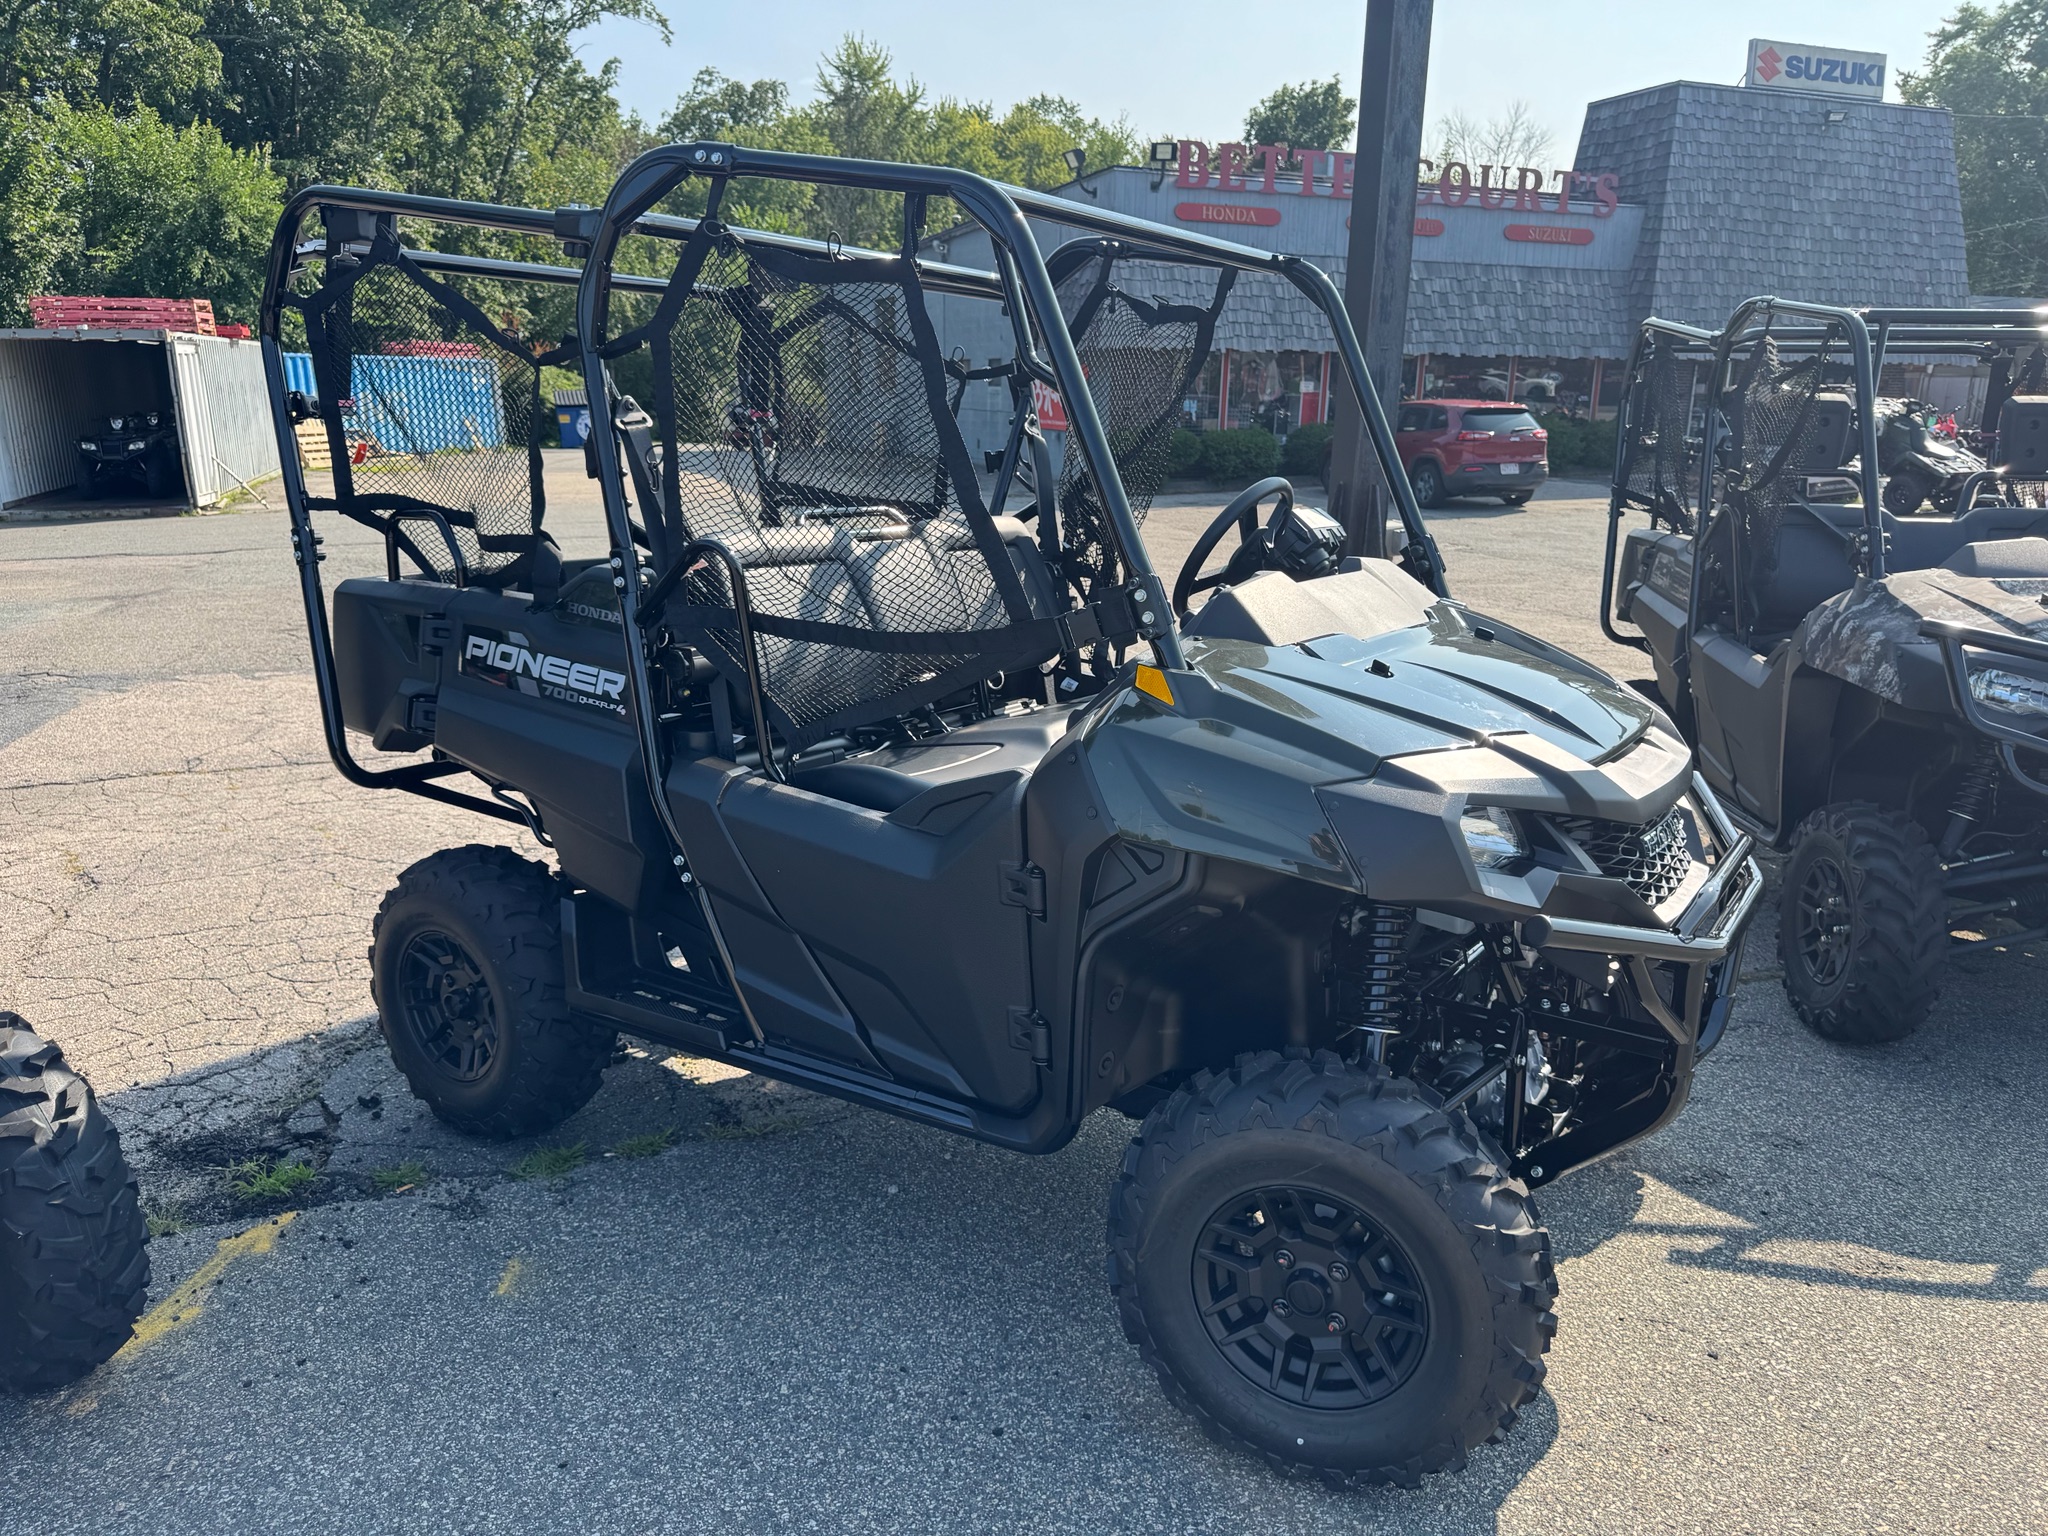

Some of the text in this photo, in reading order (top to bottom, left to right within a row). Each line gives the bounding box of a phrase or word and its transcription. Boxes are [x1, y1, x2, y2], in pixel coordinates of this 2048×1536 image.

[1785, 55, 1885, 87] SUZUKI
[1202, 205, 1257, 223] HONDA
[1528, 227, 1573, 242] SUZUKI
[567, 602, 622, 624] HONDA
[465, 635, 626, 700] PIONEER
[542, 684, 579, 703] 700
